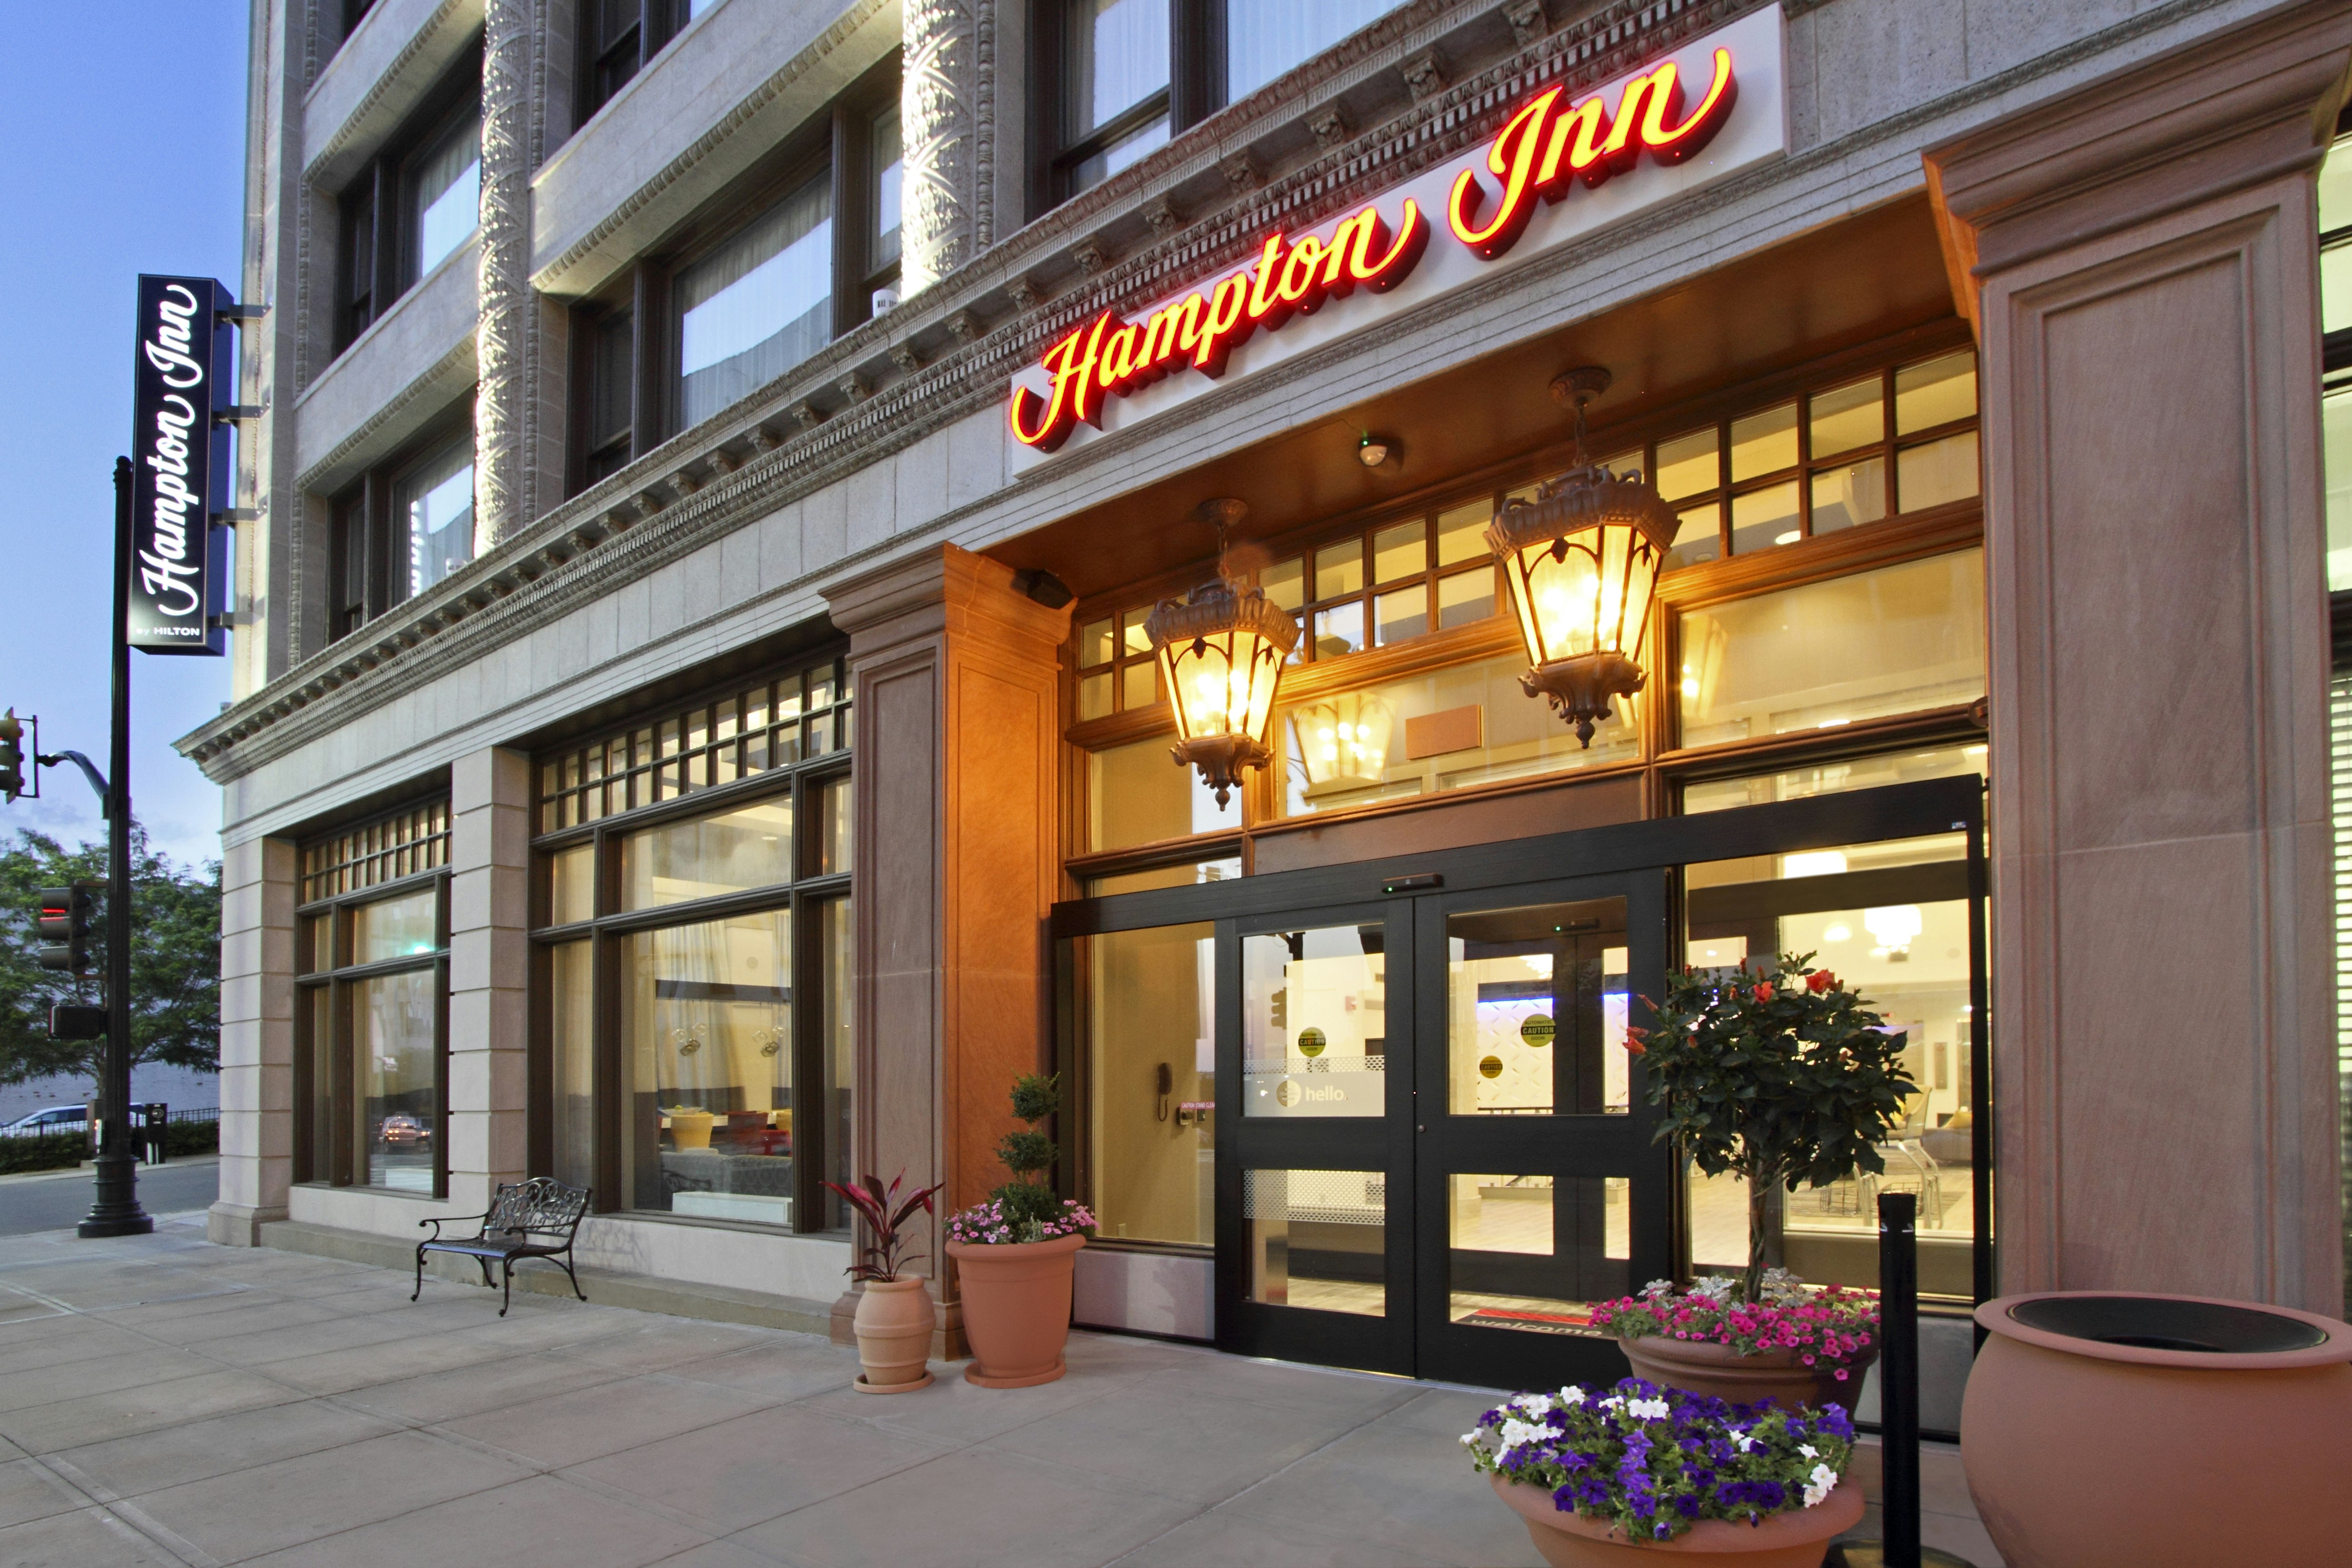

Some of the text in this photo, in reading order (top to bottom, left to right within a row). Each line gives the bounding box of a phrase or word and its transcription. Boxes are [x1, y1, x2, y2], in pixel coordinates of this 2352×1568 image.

[1010, 47, 1732, 445] Hampton Inn
[139, 284, 202, 616] Hampton Inn
[154, 627, 200, 636] HILTON
[1523, 1026, 1554, 1034] CAUTION
[1471, 1319, 1602, 1337] welcome
